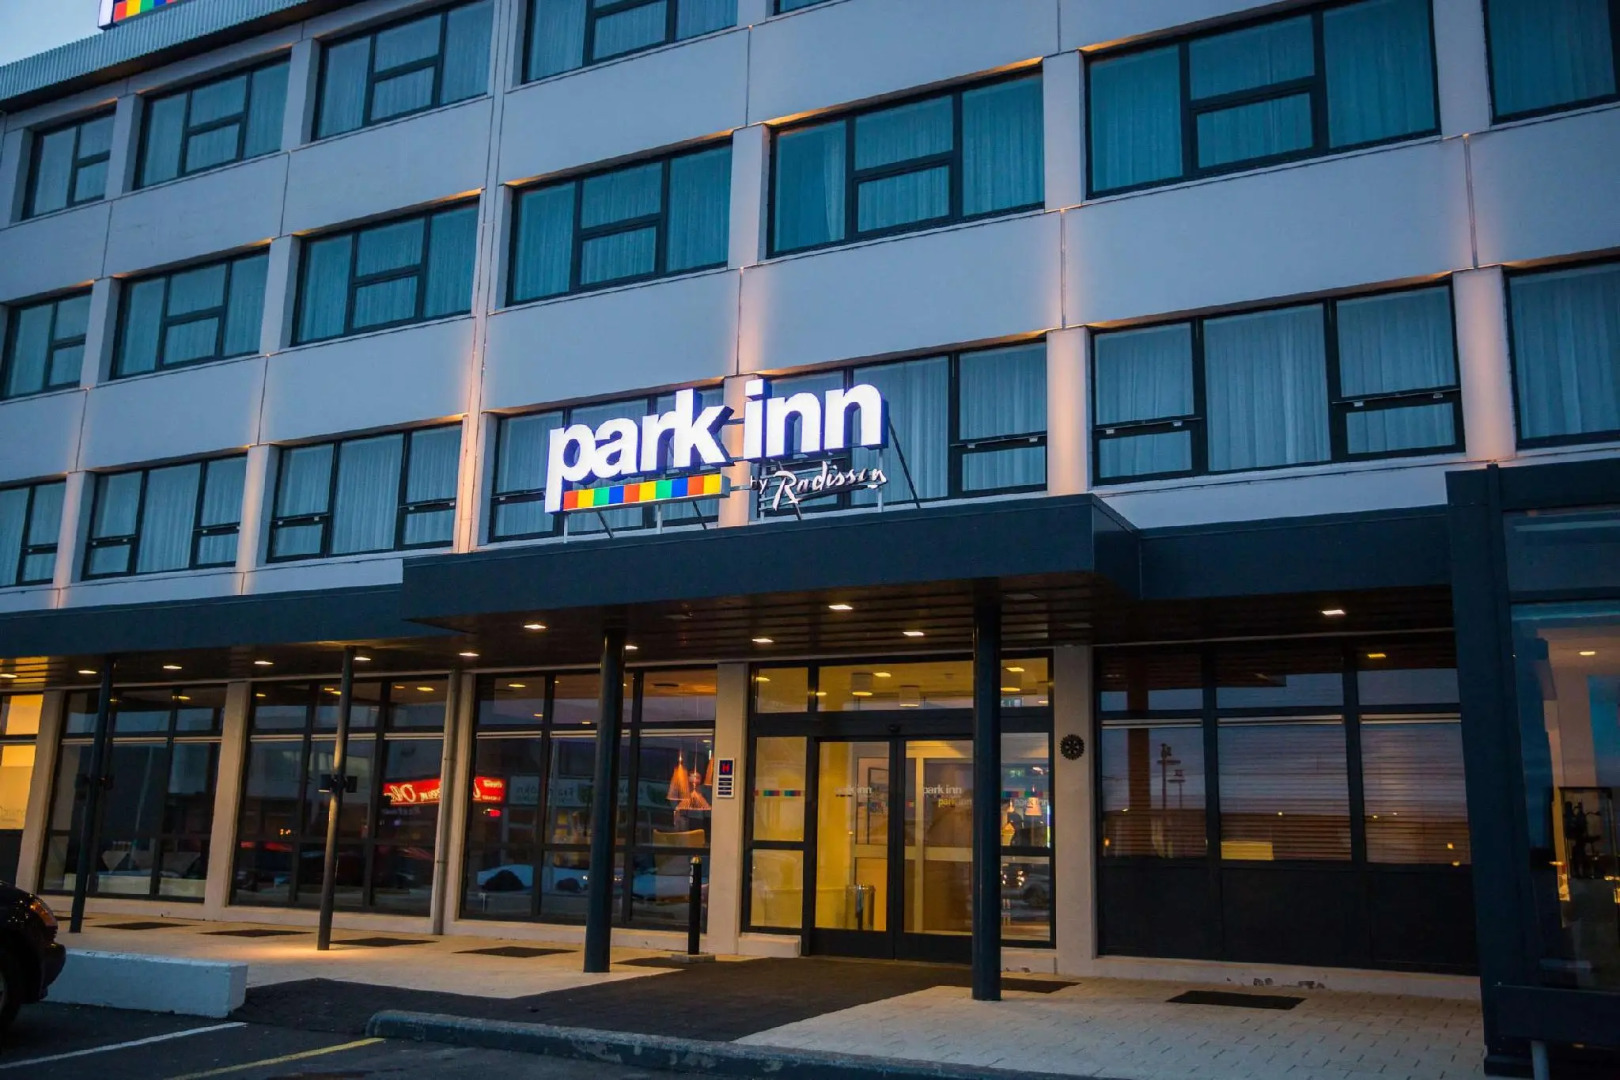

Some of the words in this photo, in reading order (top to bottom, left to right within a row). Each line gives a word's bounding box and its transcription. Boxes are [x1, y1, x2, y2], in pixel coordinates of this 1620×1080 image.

[545, 387, 733, 513] park
[743, 379, 886, 460] inn
[946, 784, 962, 794] inn
